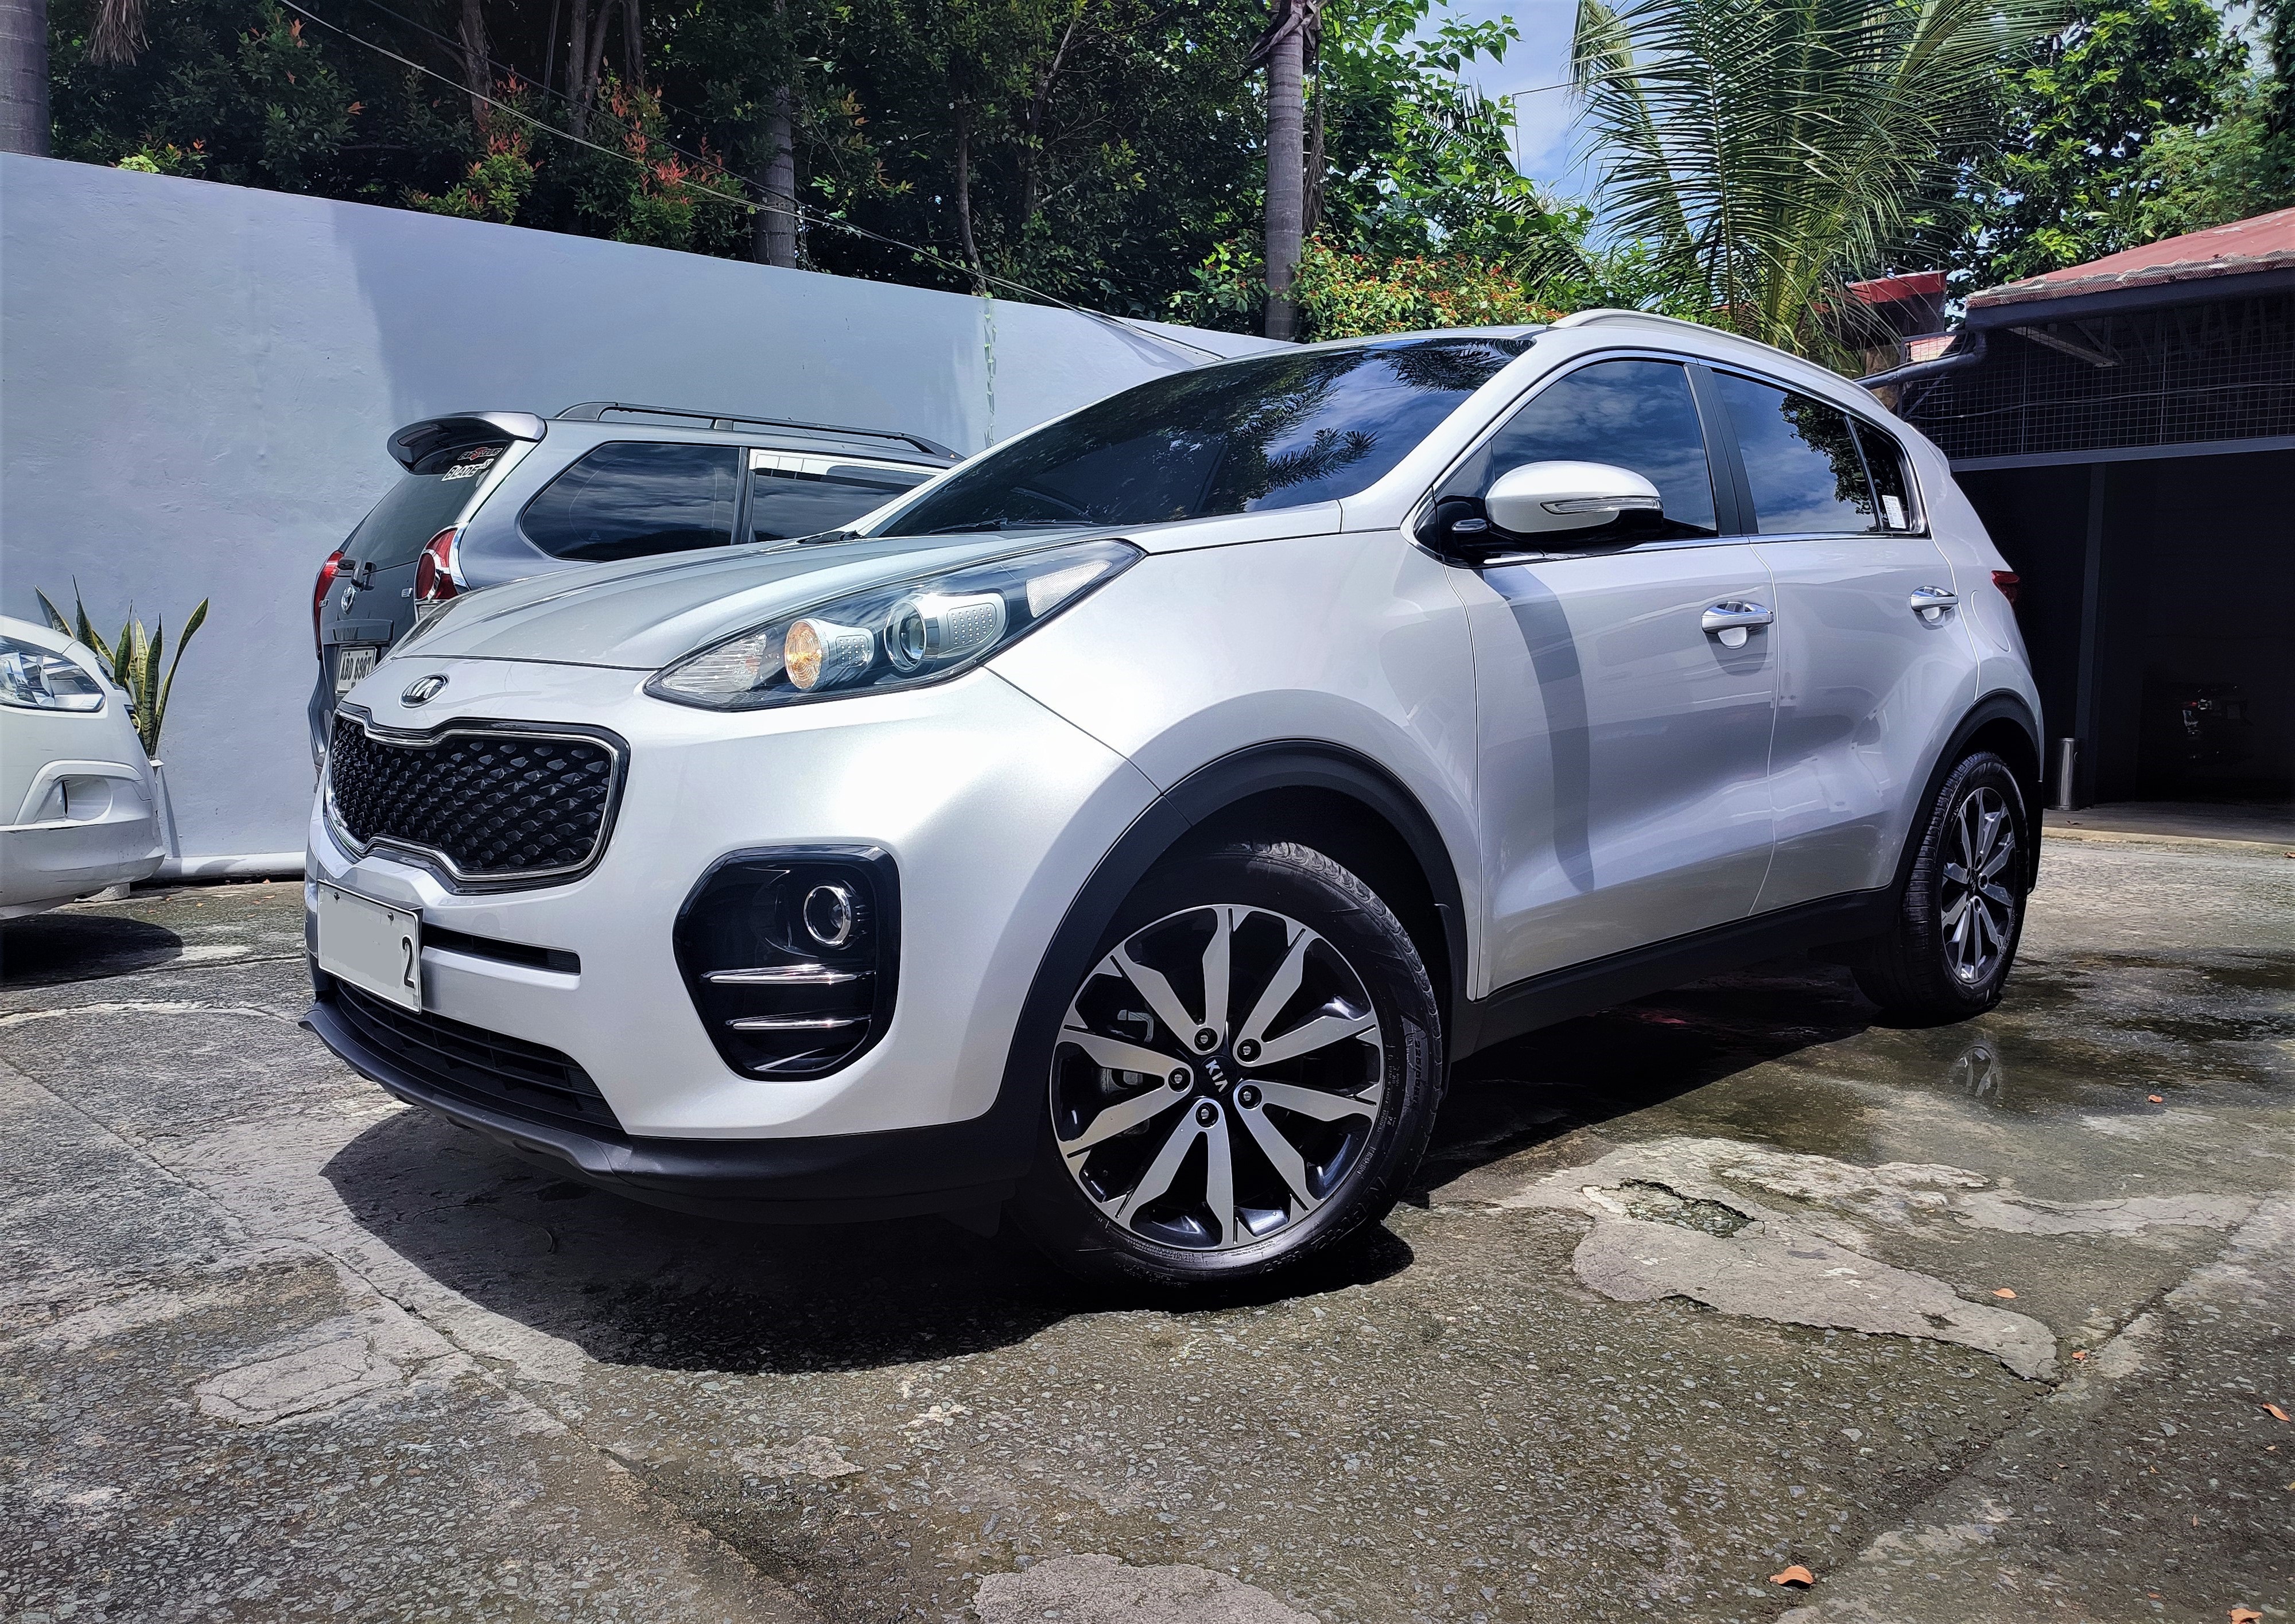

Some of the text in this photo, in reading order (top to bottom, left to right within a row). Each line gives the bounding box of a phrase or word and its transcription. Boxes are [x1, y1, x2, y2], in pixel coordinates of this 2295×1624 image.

[441, 464, 478, 481] BLADE
[340, 656, 372, 681] ABD 6987
[402, 678, 440, 699] KIA
[402, 936, 415, 989] 2
[1205, 1059, 1228, 1093] KIA
